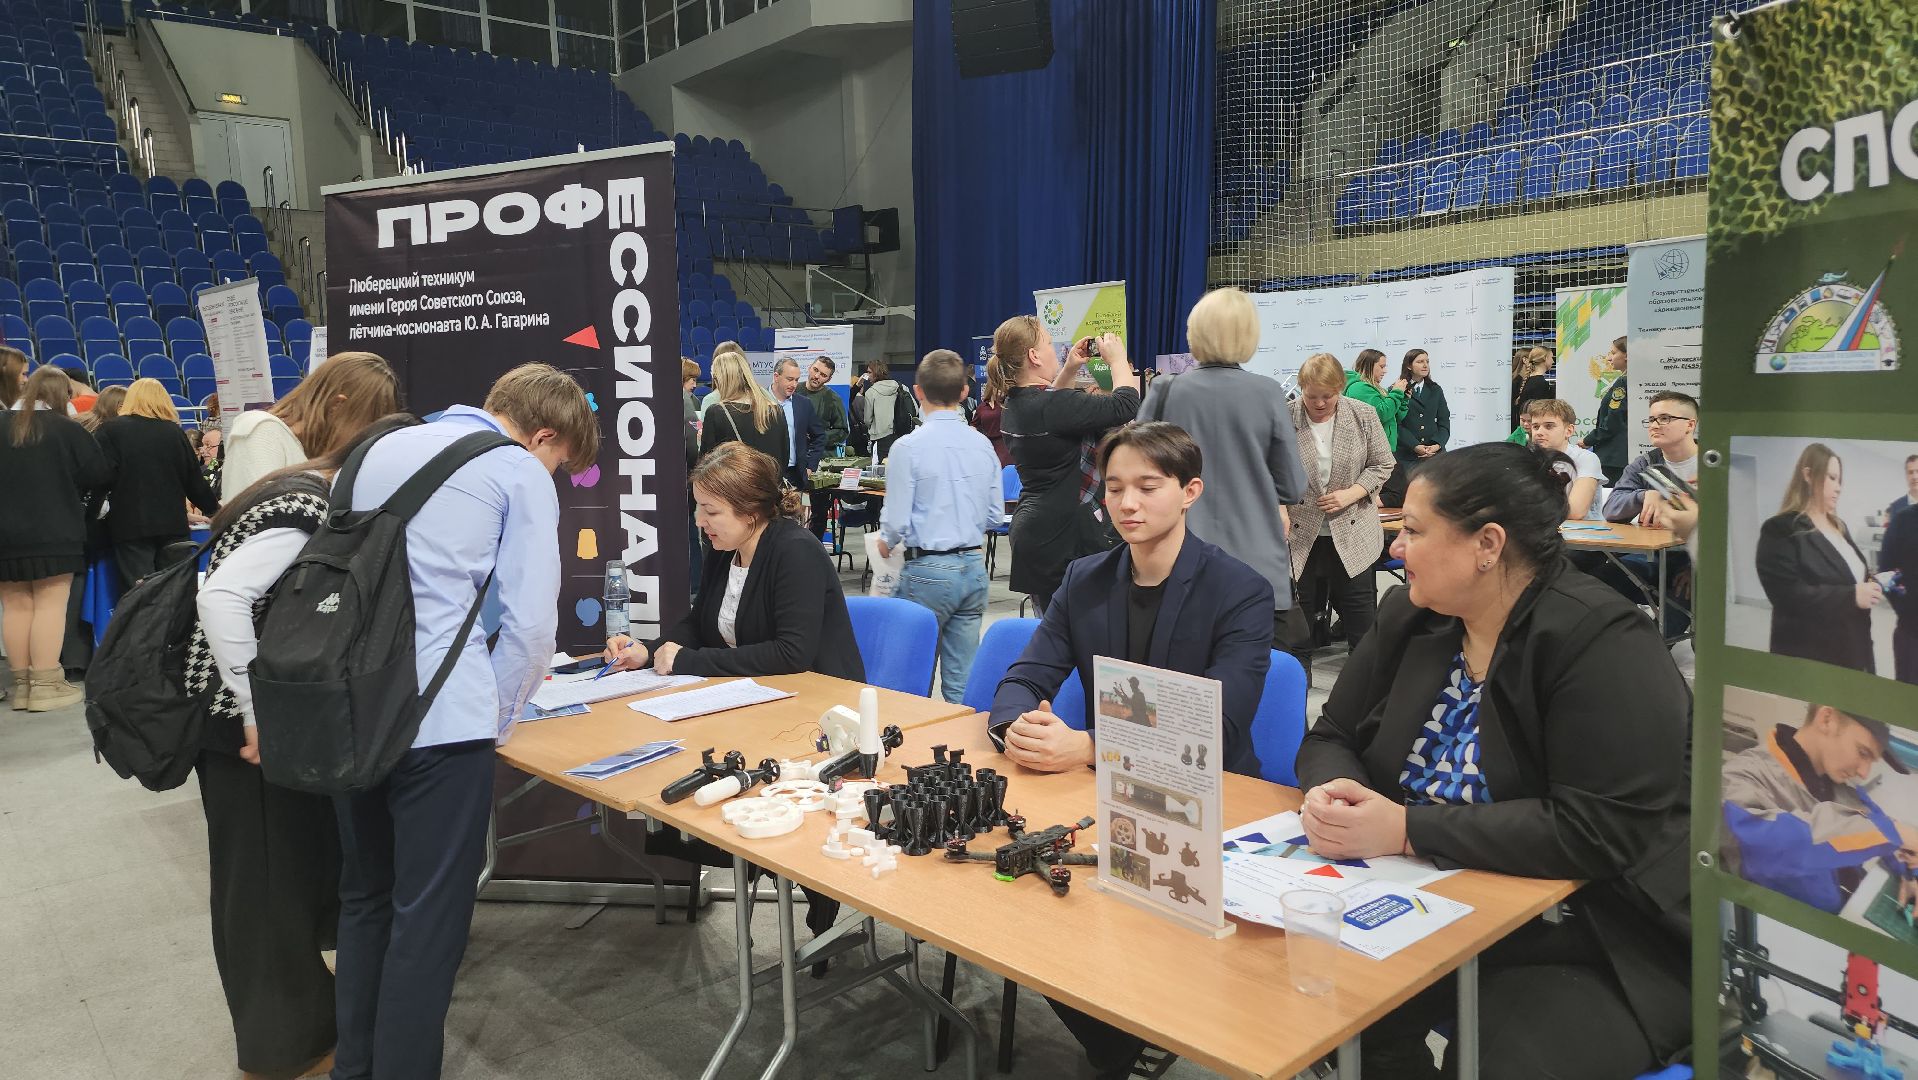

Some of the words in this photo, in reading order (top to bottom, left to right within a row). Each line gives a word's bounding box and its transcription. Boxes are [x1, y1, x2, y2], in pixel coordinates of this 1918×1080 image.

[377, 183, 604, 249] ПРОФ
[349, 272, 420, 294] Люберецкий
[421, 269, 475, 287] техникум
[349, 302, 385, 317] имени
[386, 298, 418, 317] Героя
[420, 293, 484, 311] Советского
[486, 289, 526, 305] Союза,
[349, 319, 461, 340] лётчика-космонавта
[464, 316, 479, 332] Ю.
[481, 315, 493, 330] А.
[495, 312, 550, 330] Гагарина
[752, 361, 774, 369] МТУС
[607, 177, 661, 641] ЕССИОНАЛ
